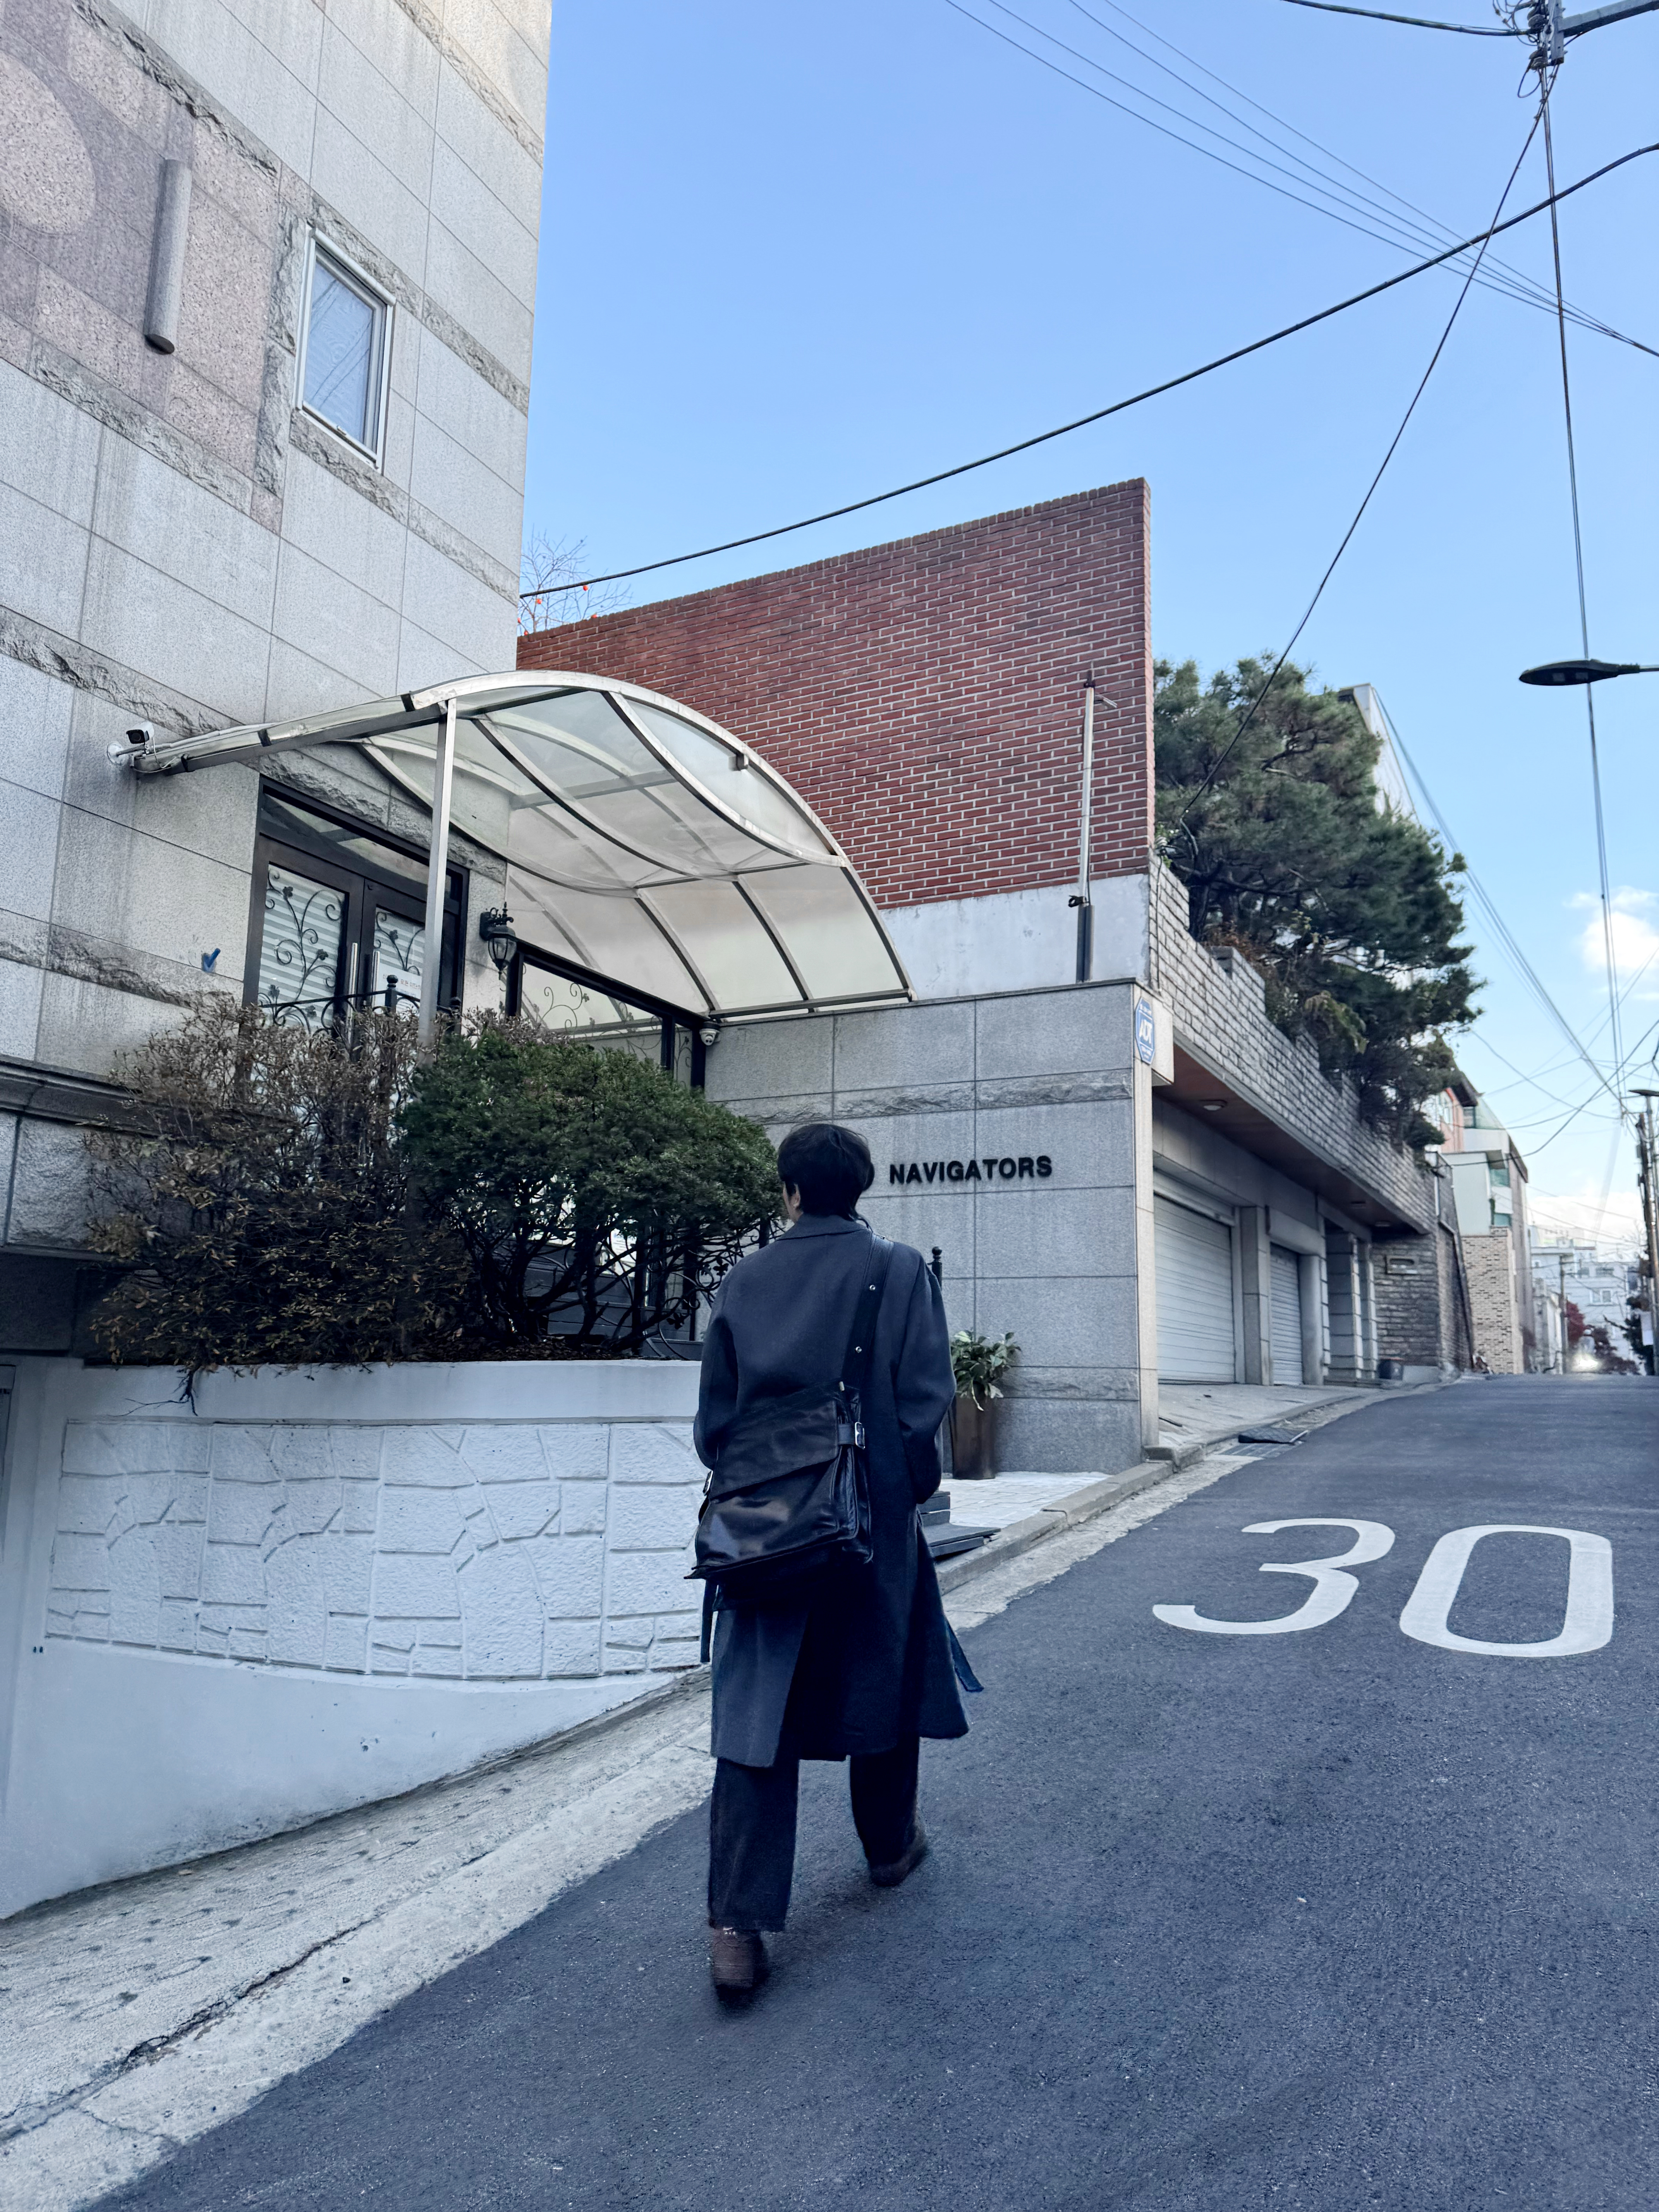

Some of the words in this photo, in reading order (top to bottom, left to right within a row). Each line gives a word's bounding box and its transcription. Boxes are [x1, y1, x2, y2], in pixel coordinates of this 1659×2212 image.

[1139, 1019, 1152, 1044] ADT
[890, 1156, 1052, 1184] NAVIGATORS
[1152, 1518, 1614, 1657] 30
